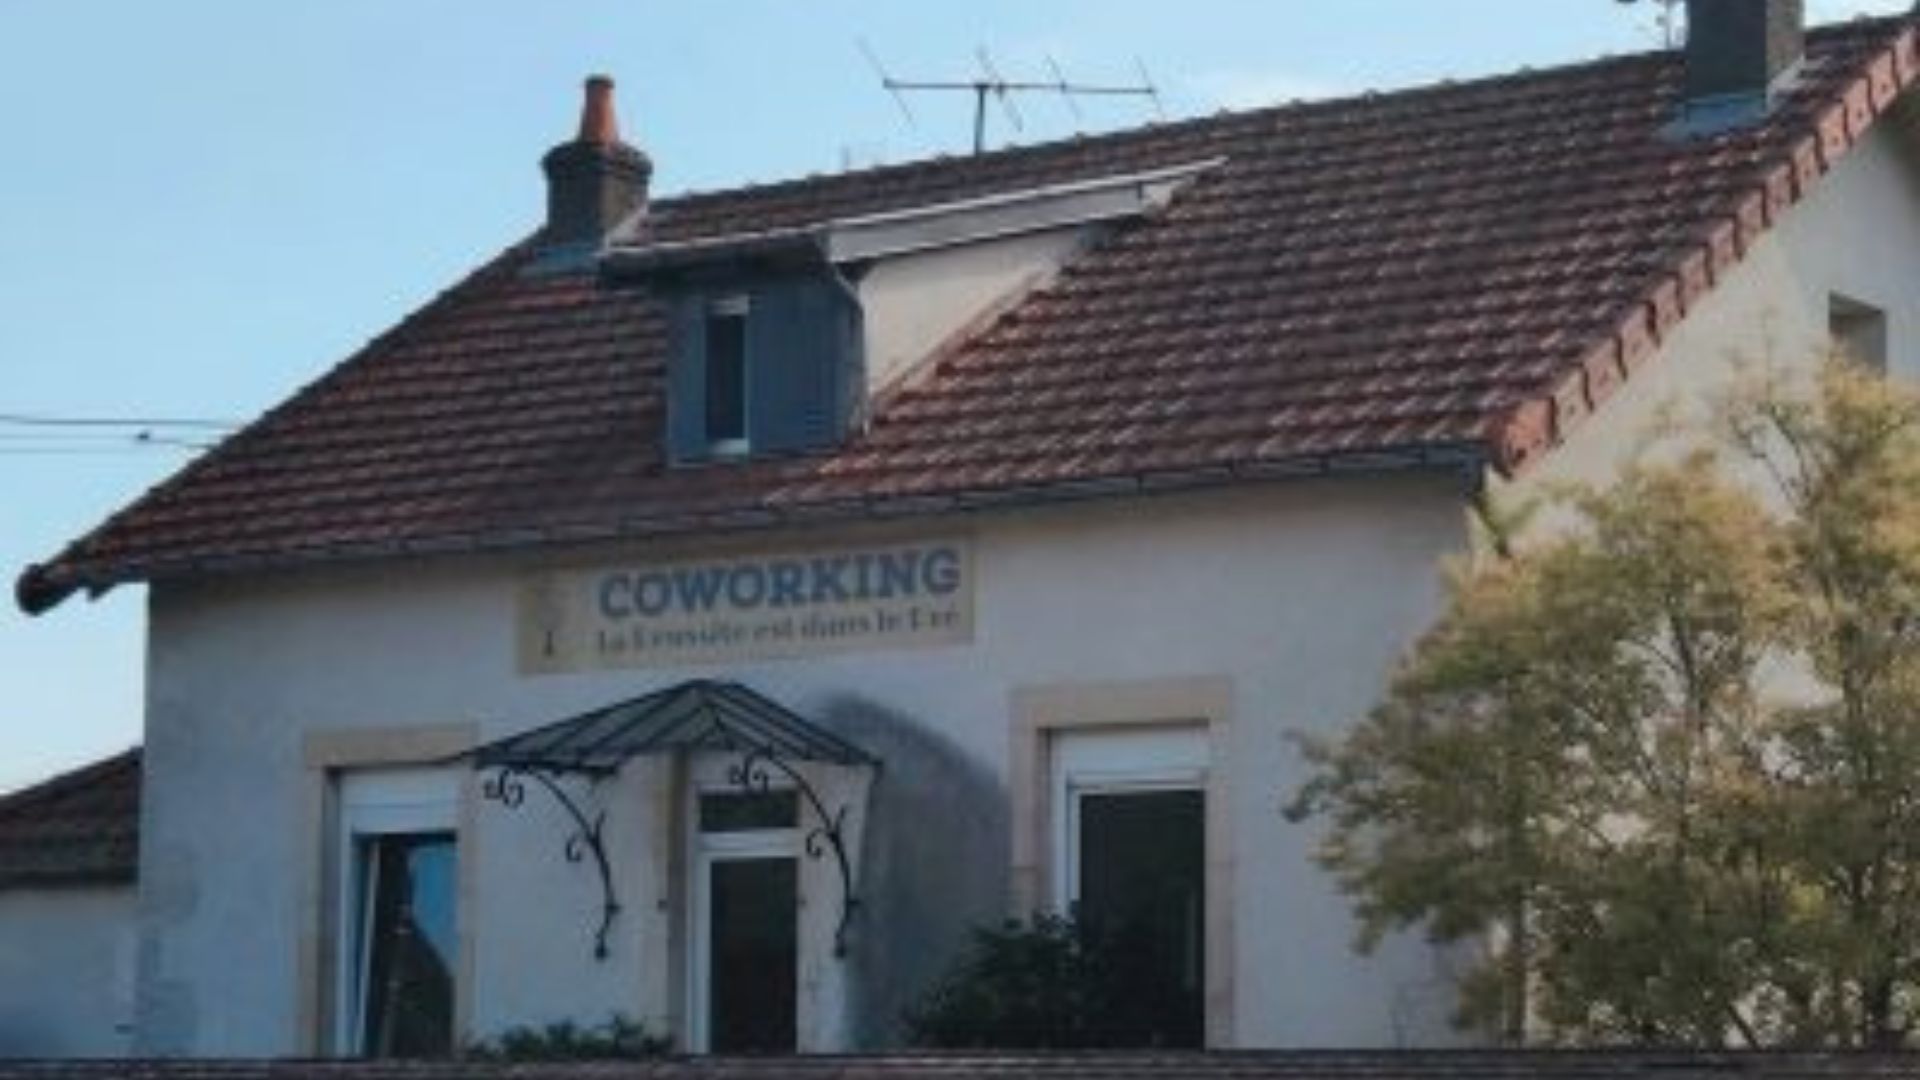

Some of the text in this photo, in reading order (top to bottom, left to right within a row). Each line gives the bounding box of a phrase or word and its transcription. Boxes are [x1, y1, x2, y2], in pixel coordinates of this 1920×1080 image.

[599, 548, 960, 618] COWORKING
[801, 613, 870, 638] dans
[877, 607, 901, 632] le
